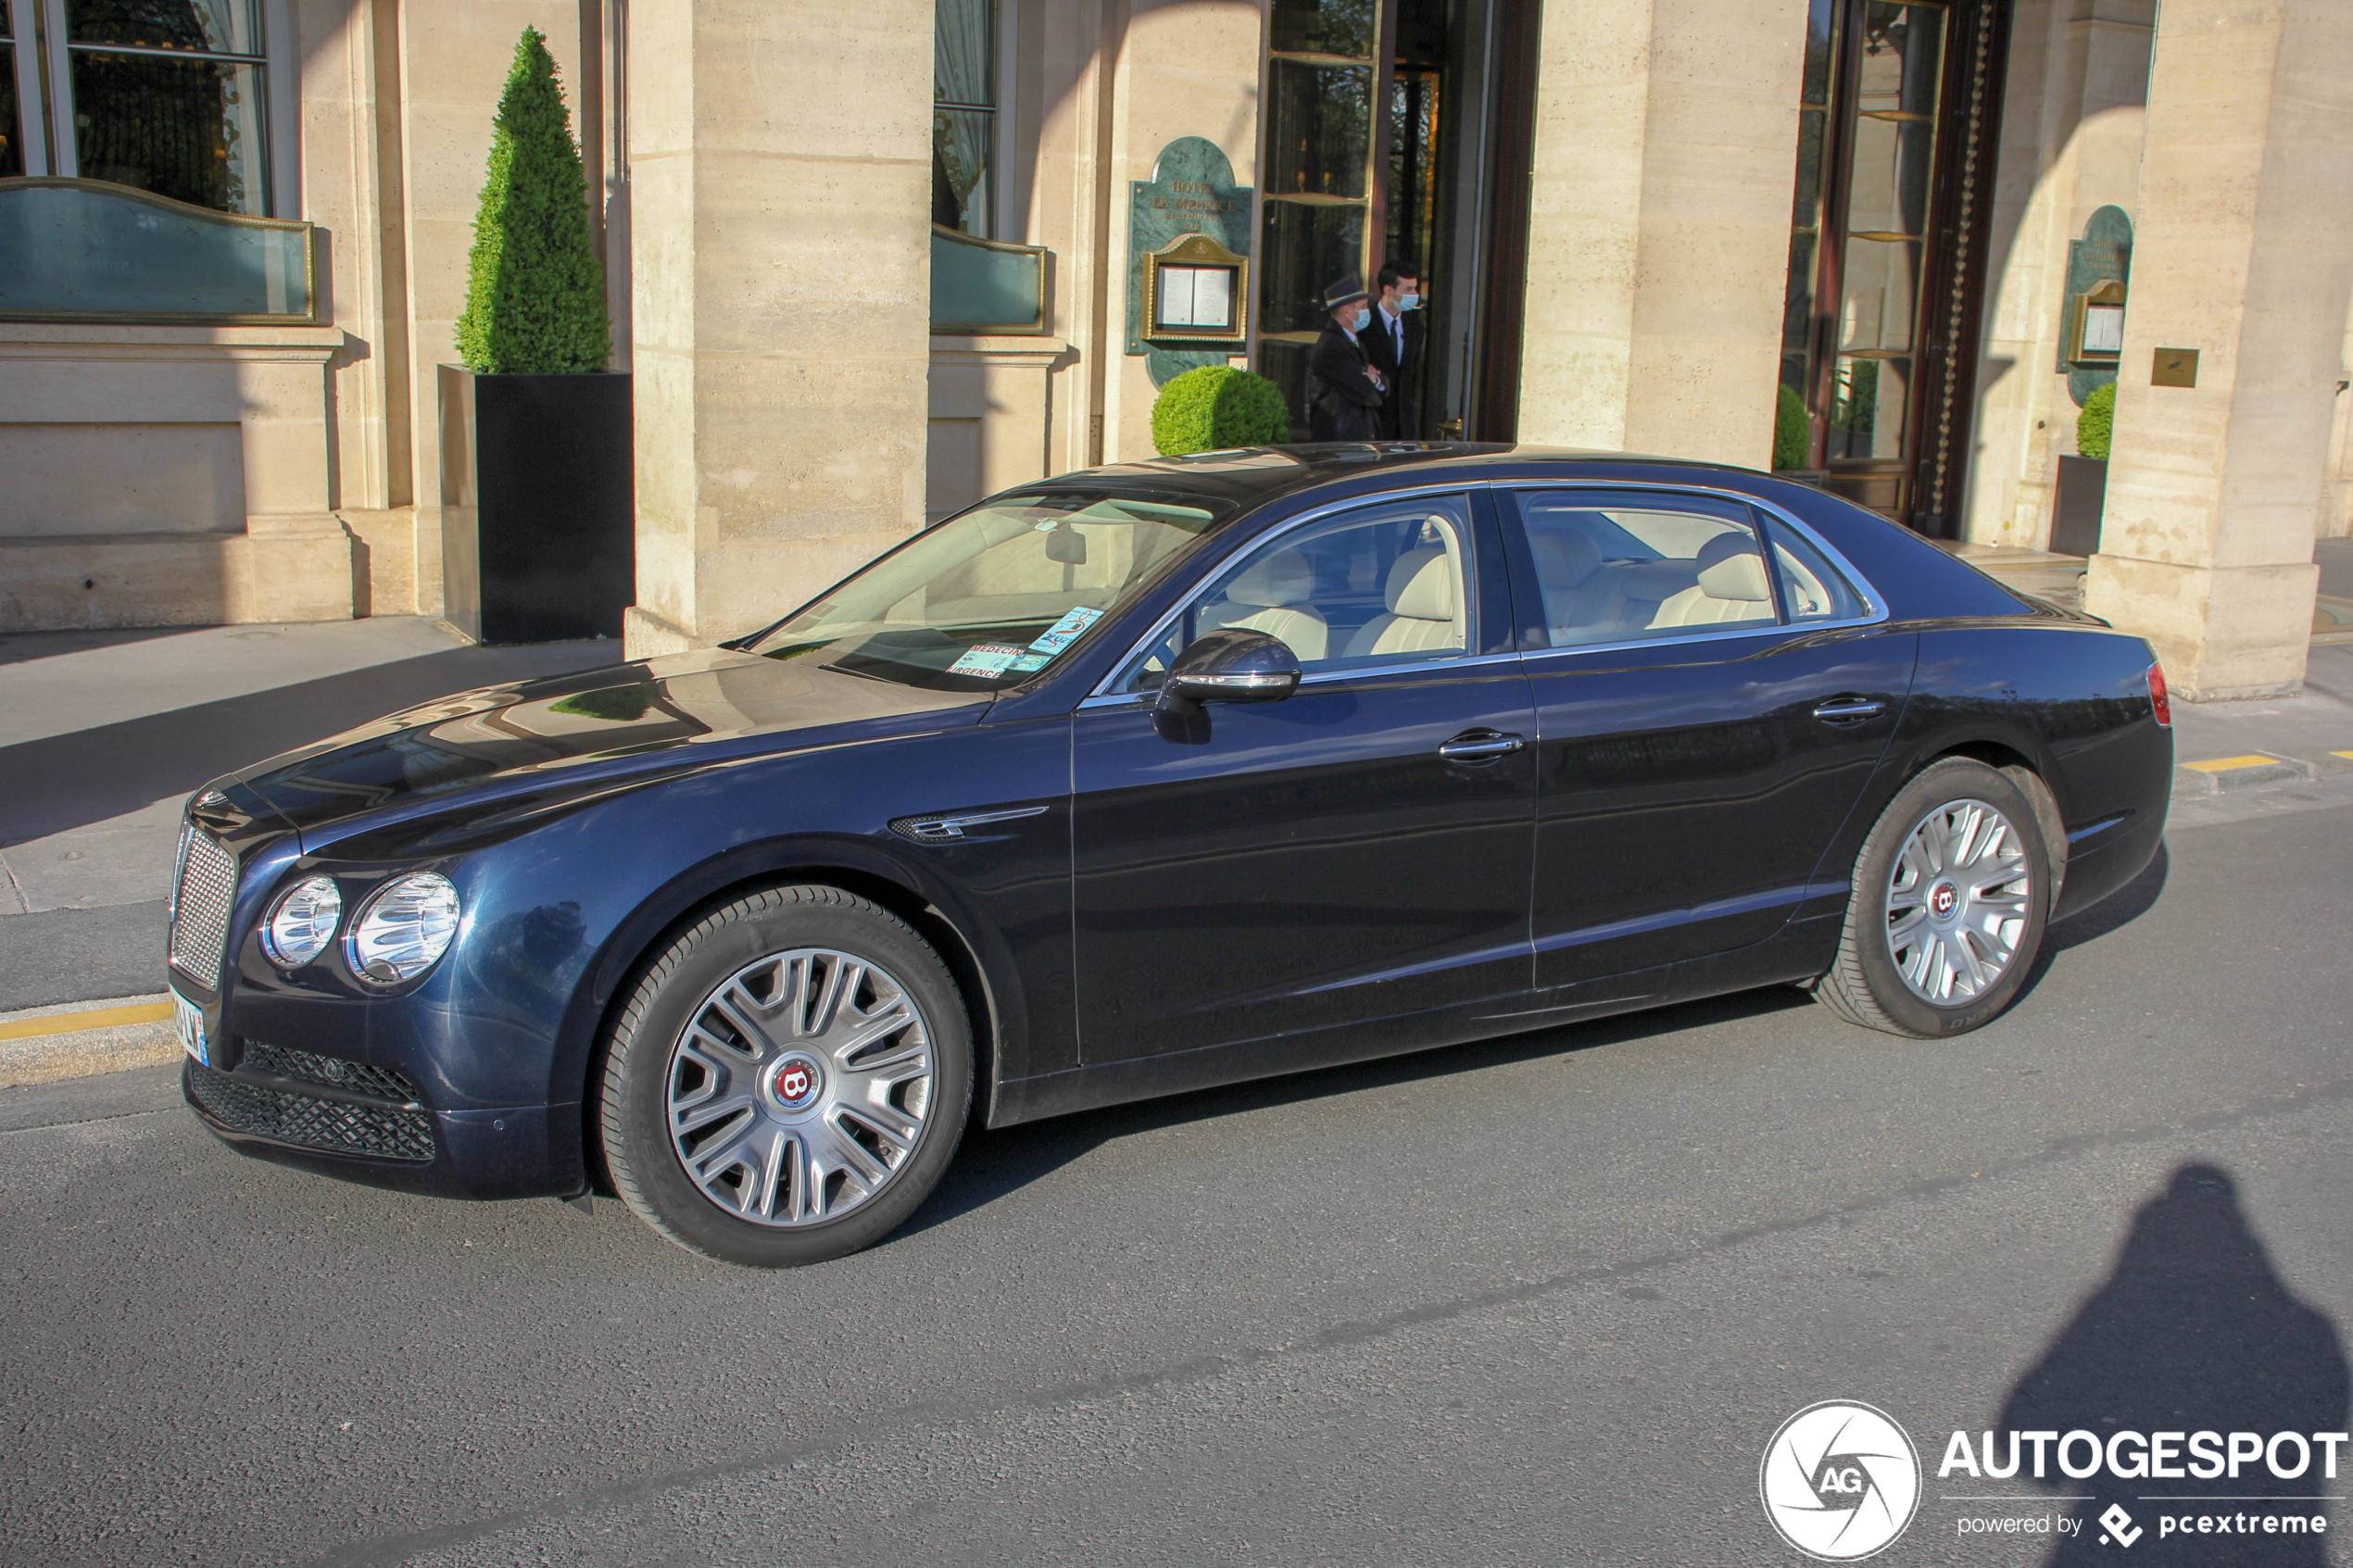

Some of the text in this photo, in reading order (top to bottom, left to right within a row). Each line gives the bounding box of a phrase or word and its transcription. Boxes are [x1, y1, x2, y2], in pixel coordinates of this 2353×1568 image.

[1172, 181, 1214, 195] HOTEL
[1151, 196, 1235, 211] LE MEURICE
[1164, 212, 1221, 222] RESTAURANT
[1183, 222, 1202, 231] BAR
[1041, 633, 1073, 645] 2021
[970, 645, 1023, 656] MEDECIN
[947, 666, 1002, 679] URGENCE
